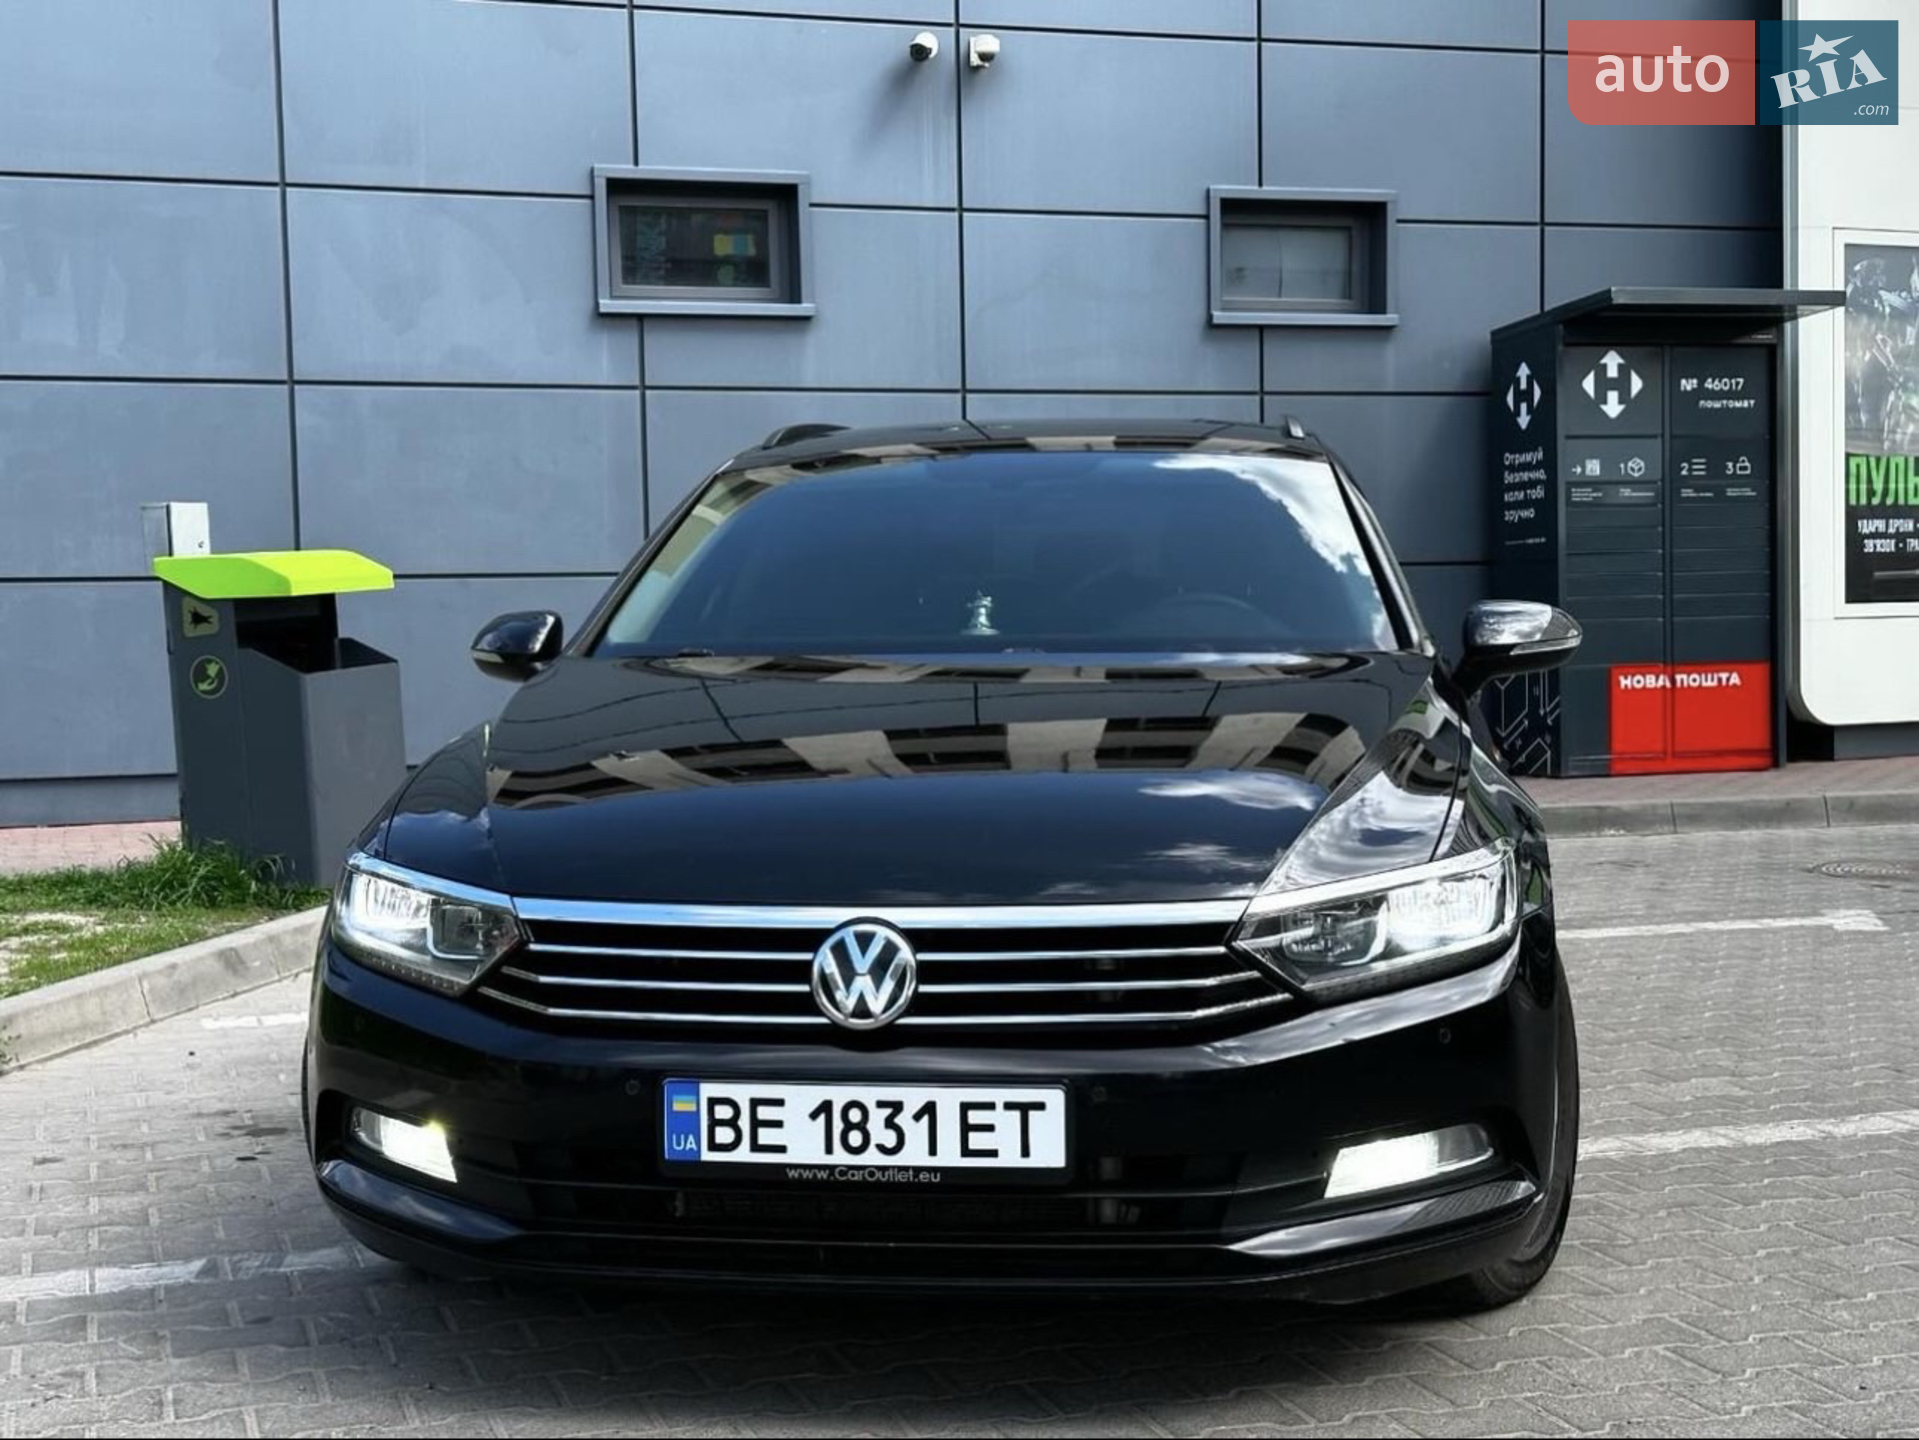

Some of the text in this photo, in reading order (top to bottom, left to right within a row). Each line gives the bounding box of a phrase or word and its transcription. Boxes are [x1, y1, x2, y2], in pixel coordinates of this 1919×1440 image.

[1704, 377, 1745, 391] 46017
[1503, 446, 1544, 468] Отримуй
[1619, 463, 1625, 476] 1
[1680, 462, 1689, 475] 2
[1725, 462, 1735, 475] 3
[1526, 485, 1545, 499] тобі
[1503, 508, 1536, 523] зручно
[1887, 518, 1914, 534] ДРОНИ
[1619, 671, 1742, 689] НОВА ПОШТА
[706, 1096, 1047, 1158] BE 1831 ET
[671, 1134, 698, 1151] UA
[785, 1166, 942, 1183] www.CarOutlet.eu
